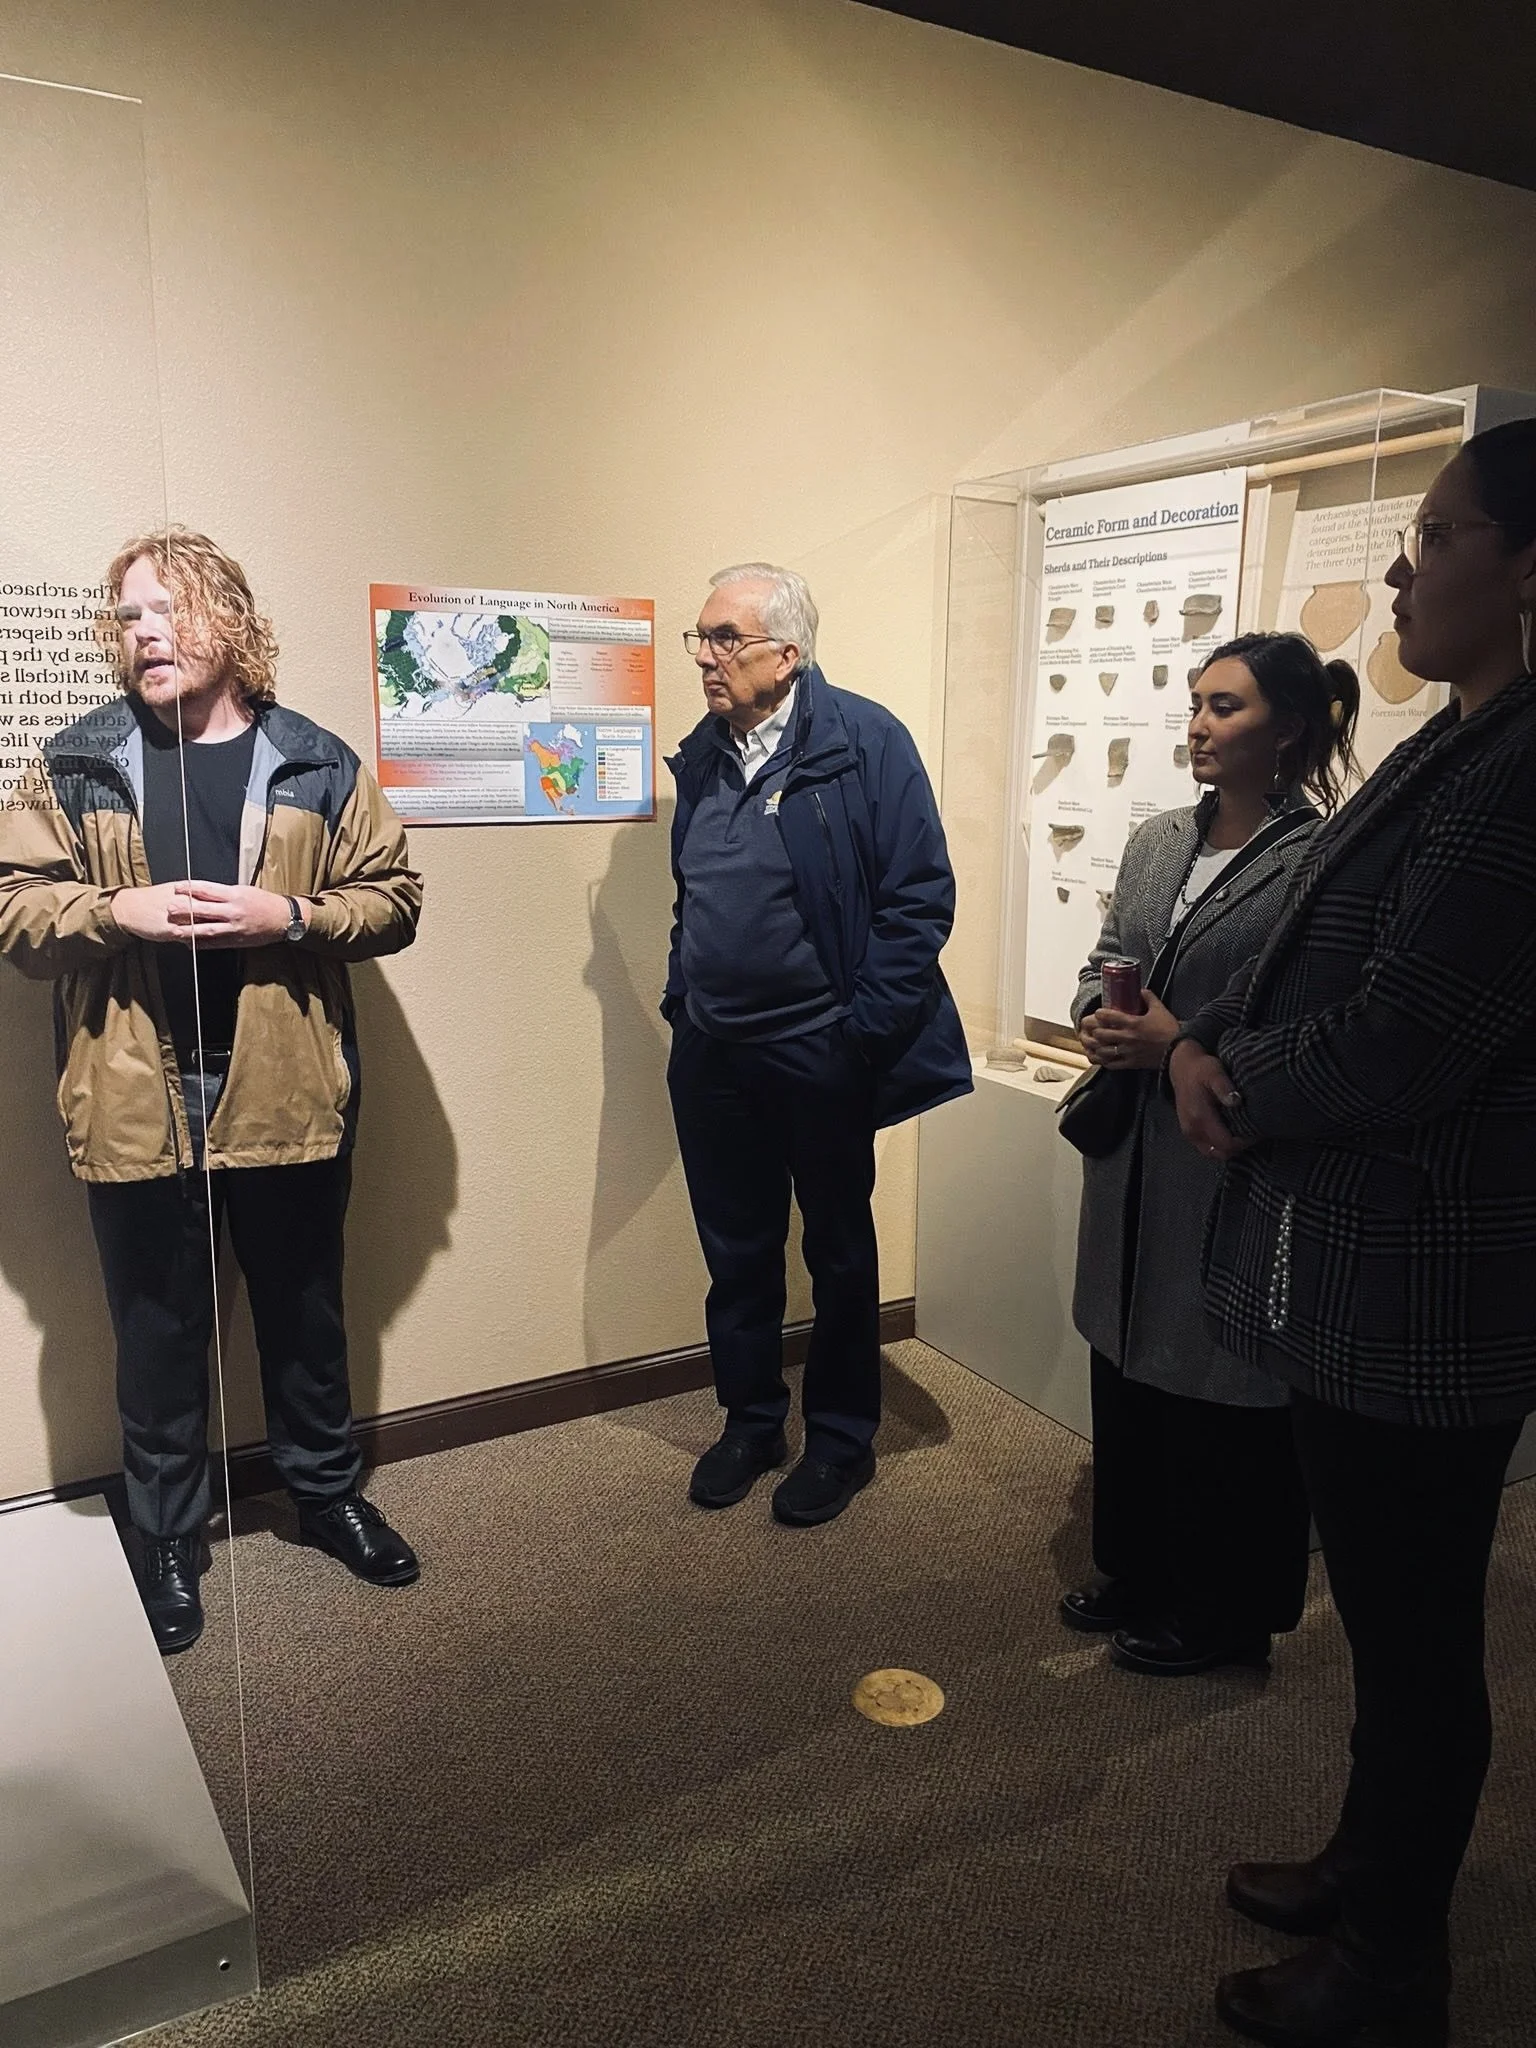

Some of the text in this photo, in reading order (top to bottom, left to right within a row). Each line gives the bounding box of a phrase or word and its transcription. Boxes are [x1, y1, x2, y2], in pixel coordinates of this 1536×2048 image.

[1377, 501, 1404, 513] divide
[1406, 498, 1420, 508] the
[1046, 501, 1239, 541] Ceramic Form and Decoration
[1311, 523, 1337, 534] found
[1337, 522, 1347, 531] at
[1347, 519, 1362, 529] the
[1309, 533, 1353, 547] categories.
[1307, 544, 1355, 558] determined
[1356, 543, 1367, 554] by
[1370, 541, 1385, 551] the
[1044, 551, 1168, 575] Sherds and Their Descriptions
[1306, 560, 1321, 570] The
[1323, 557, 1345, 568] three
[408, 591, 620, 613] Evolution of Language in North America
[1371, 708, 1428, 718] Foreman Ware
